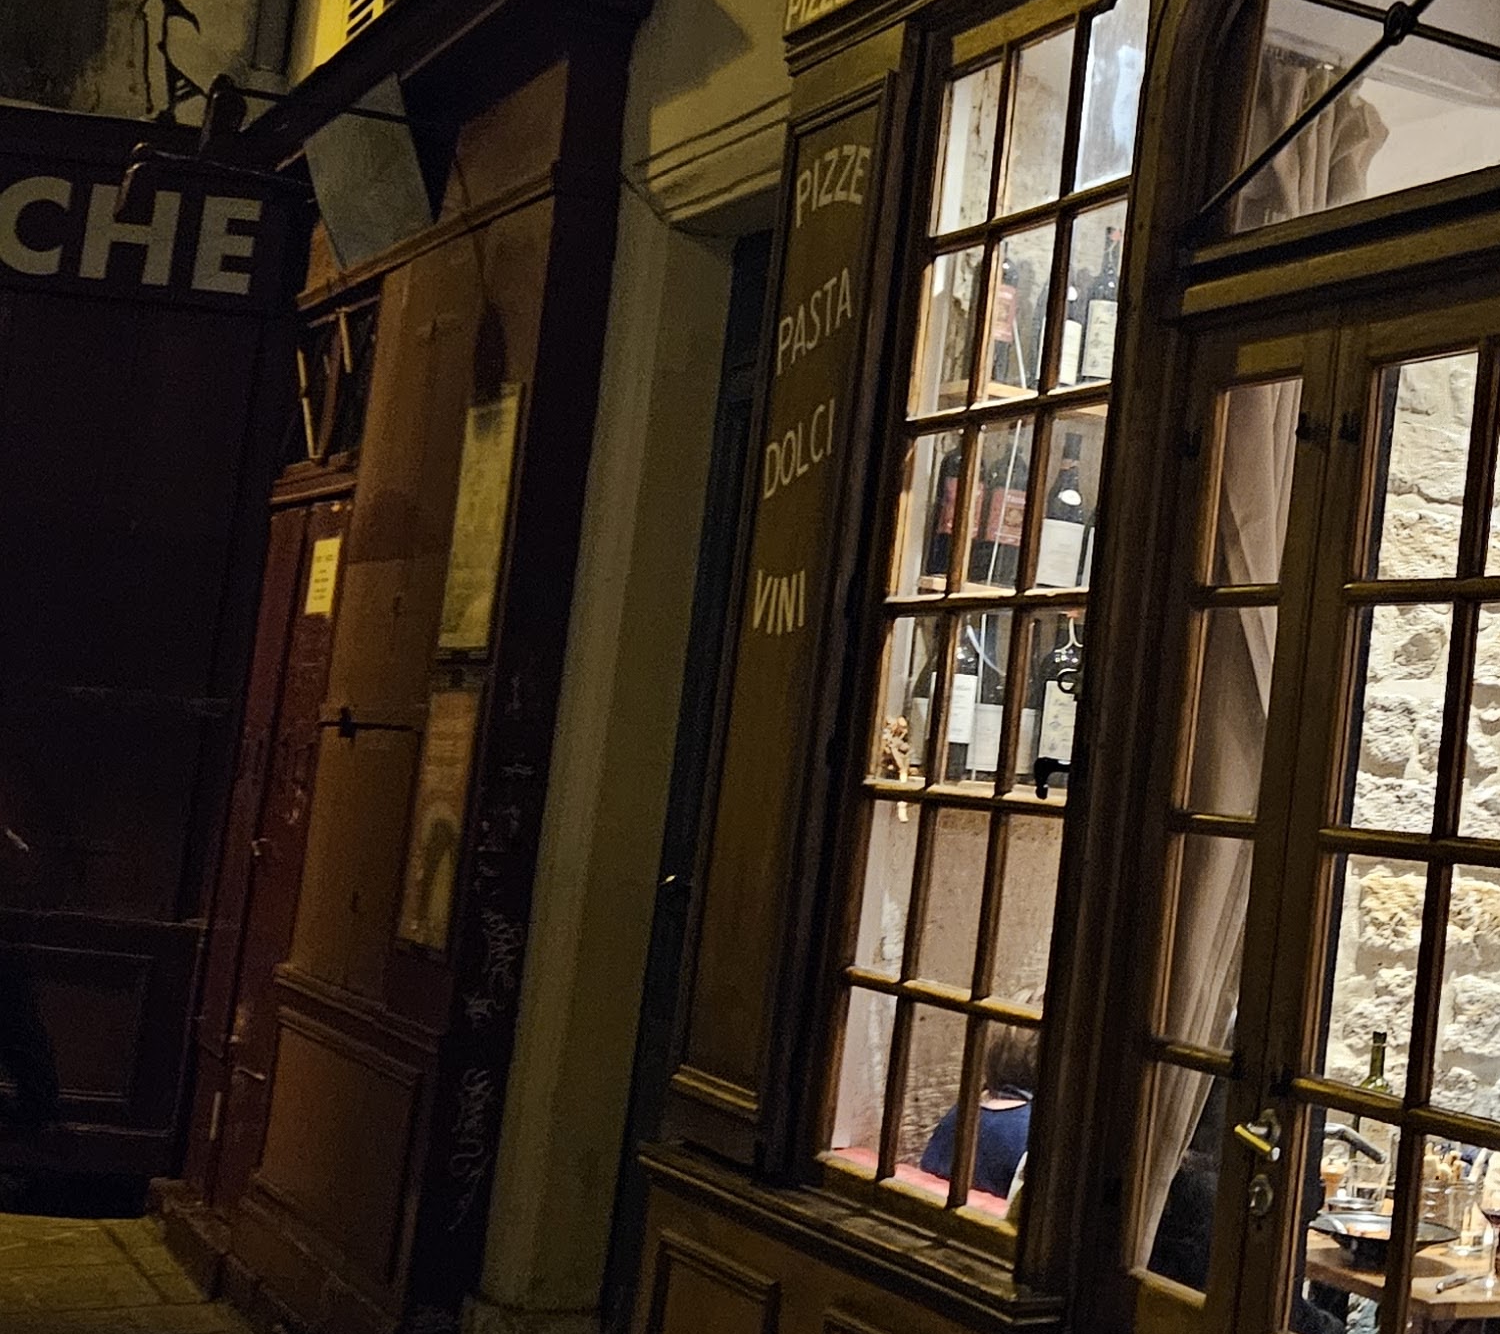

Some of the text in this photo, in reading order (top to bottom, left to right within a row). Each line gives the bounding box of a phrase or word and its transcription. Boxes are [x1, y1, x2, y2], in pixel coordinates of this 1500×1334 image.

[0, 176, 263, 295] CHE
[795, 143, 870, 228] PIZZE
[776, 267, 853, 376] PASTA
[763, 398, 835, 499] DOLCI
[751, 570, 806, 635] VINI
